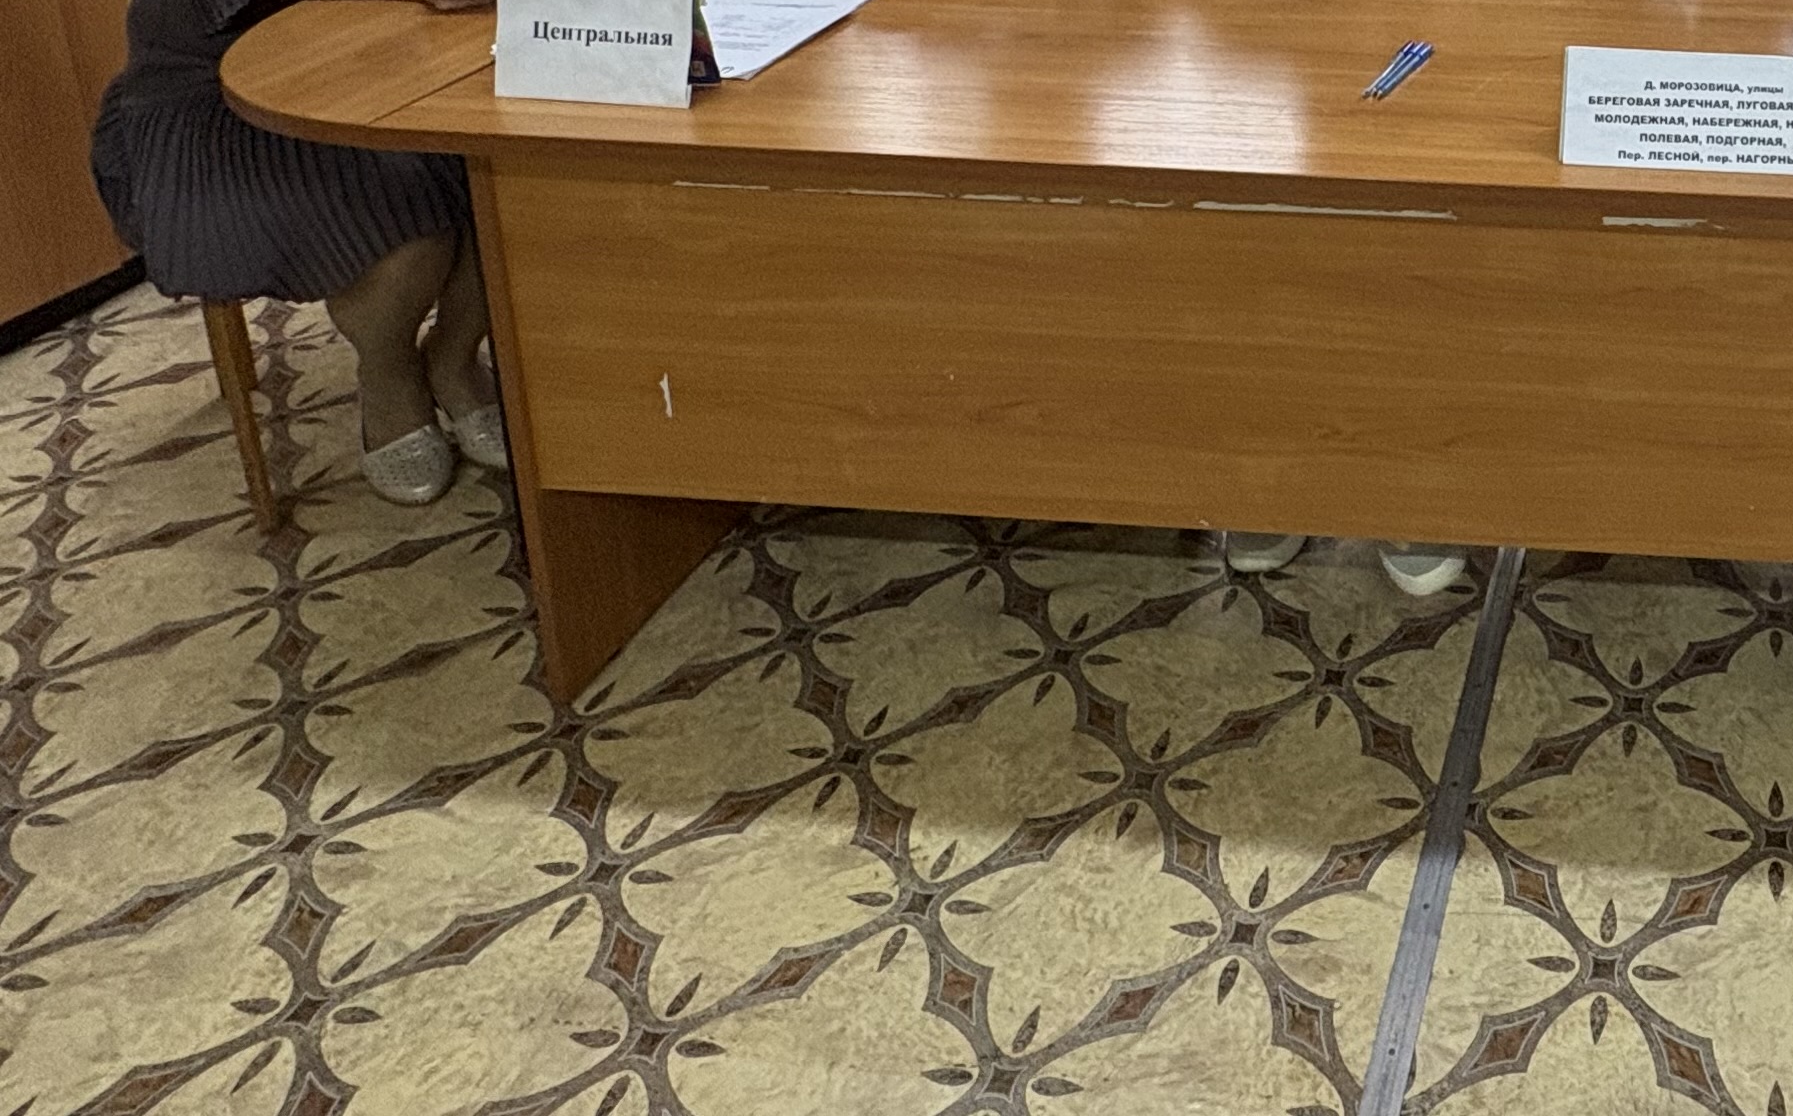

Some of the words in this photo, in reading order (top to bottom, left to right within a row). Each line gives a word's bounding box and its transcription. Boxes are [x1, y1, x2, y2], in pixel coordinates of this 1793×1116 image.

[532, 21, 674, 46] Центральная
[1644, 81, 1656, 91] Д.
[1660, 82, 1744, 93] МОРОЗОВИЦА,
[1748, 85, 1784, 95] улицы
[1588, 95, 1660, 107] БЕРЕГОВАЯ
[1664, 98, 1733, 111] ЗАРЕЧНАЯ,
[1595, 113, 1688, 127] МОЛОДЕЖНАЯ,
[1692, 117, 1782, 130] НАБЕРЕЖНАЯ,
[1640, 134, 1702, 145] ПОЛЕВАЯ,
[1706, 136, 1786, 148] ПОДГОРНАЯ,
[1618, 151, 1644, 161] Пер.
[1648, 151, 1703, 163] ЛЕСНОЙ,
[1707, 156, 1732, 164] пер.
